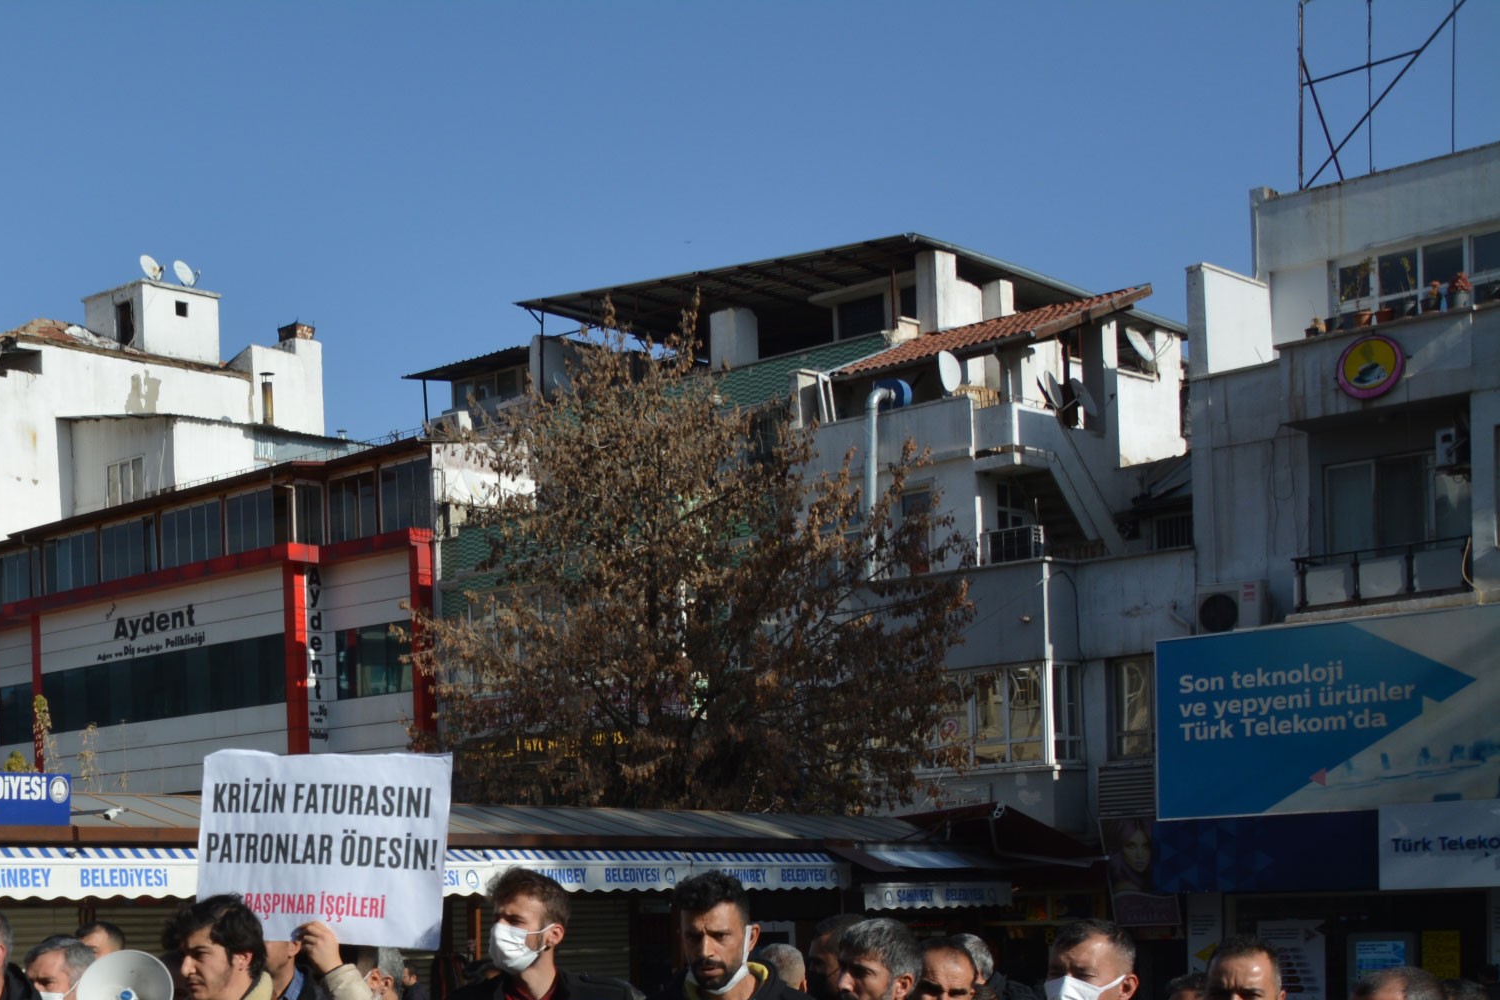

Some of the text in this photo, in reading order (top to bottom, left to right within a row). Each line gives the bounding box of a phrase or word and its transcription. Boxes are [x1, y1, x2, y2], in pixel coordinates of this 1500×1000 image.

[113, 604, 195, 641] Aydent
[1179, 660, 1344, 694] Son teknoloji
[1179, 681, 1416, 718] ve yepyeni ürünler
[1179, 709, 1388, 742] Türk Telekom'da
[212, 778, 432, 818] KRİZİN FATURASINI
[205, 829, 438, 871] PATRONLAR ÖDESİN!
[1392, 836, 1433, 853] Türk
[245, 891, 386, 923] BAŞPINAR İŞÇİLERİ
